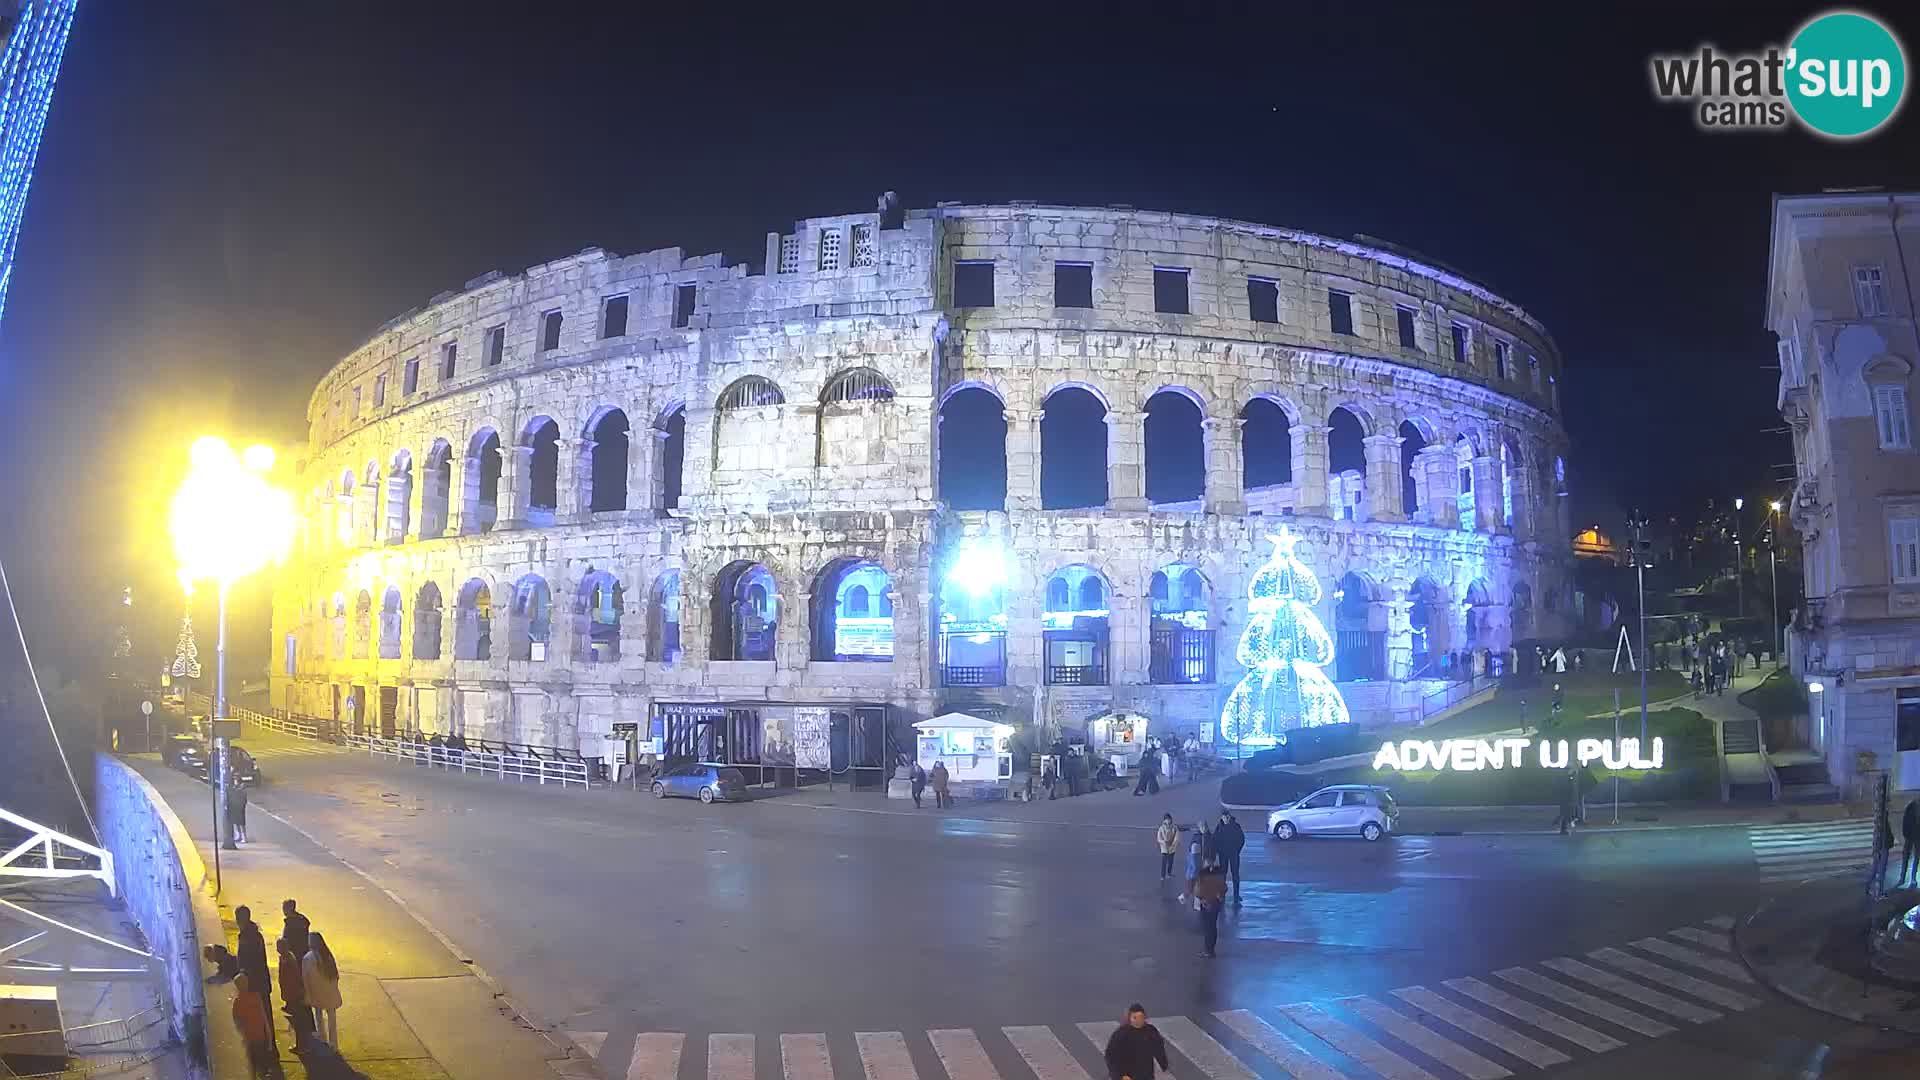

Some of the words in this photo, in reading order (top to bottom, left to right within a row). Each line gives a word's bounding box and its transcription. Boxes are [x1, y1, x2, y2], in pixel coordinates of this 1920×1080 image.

[1372, 739, 1531, 771] ADVENT
[1539, 739, 1569, 769] U
[1576, 736, 1664, 770] PULI
